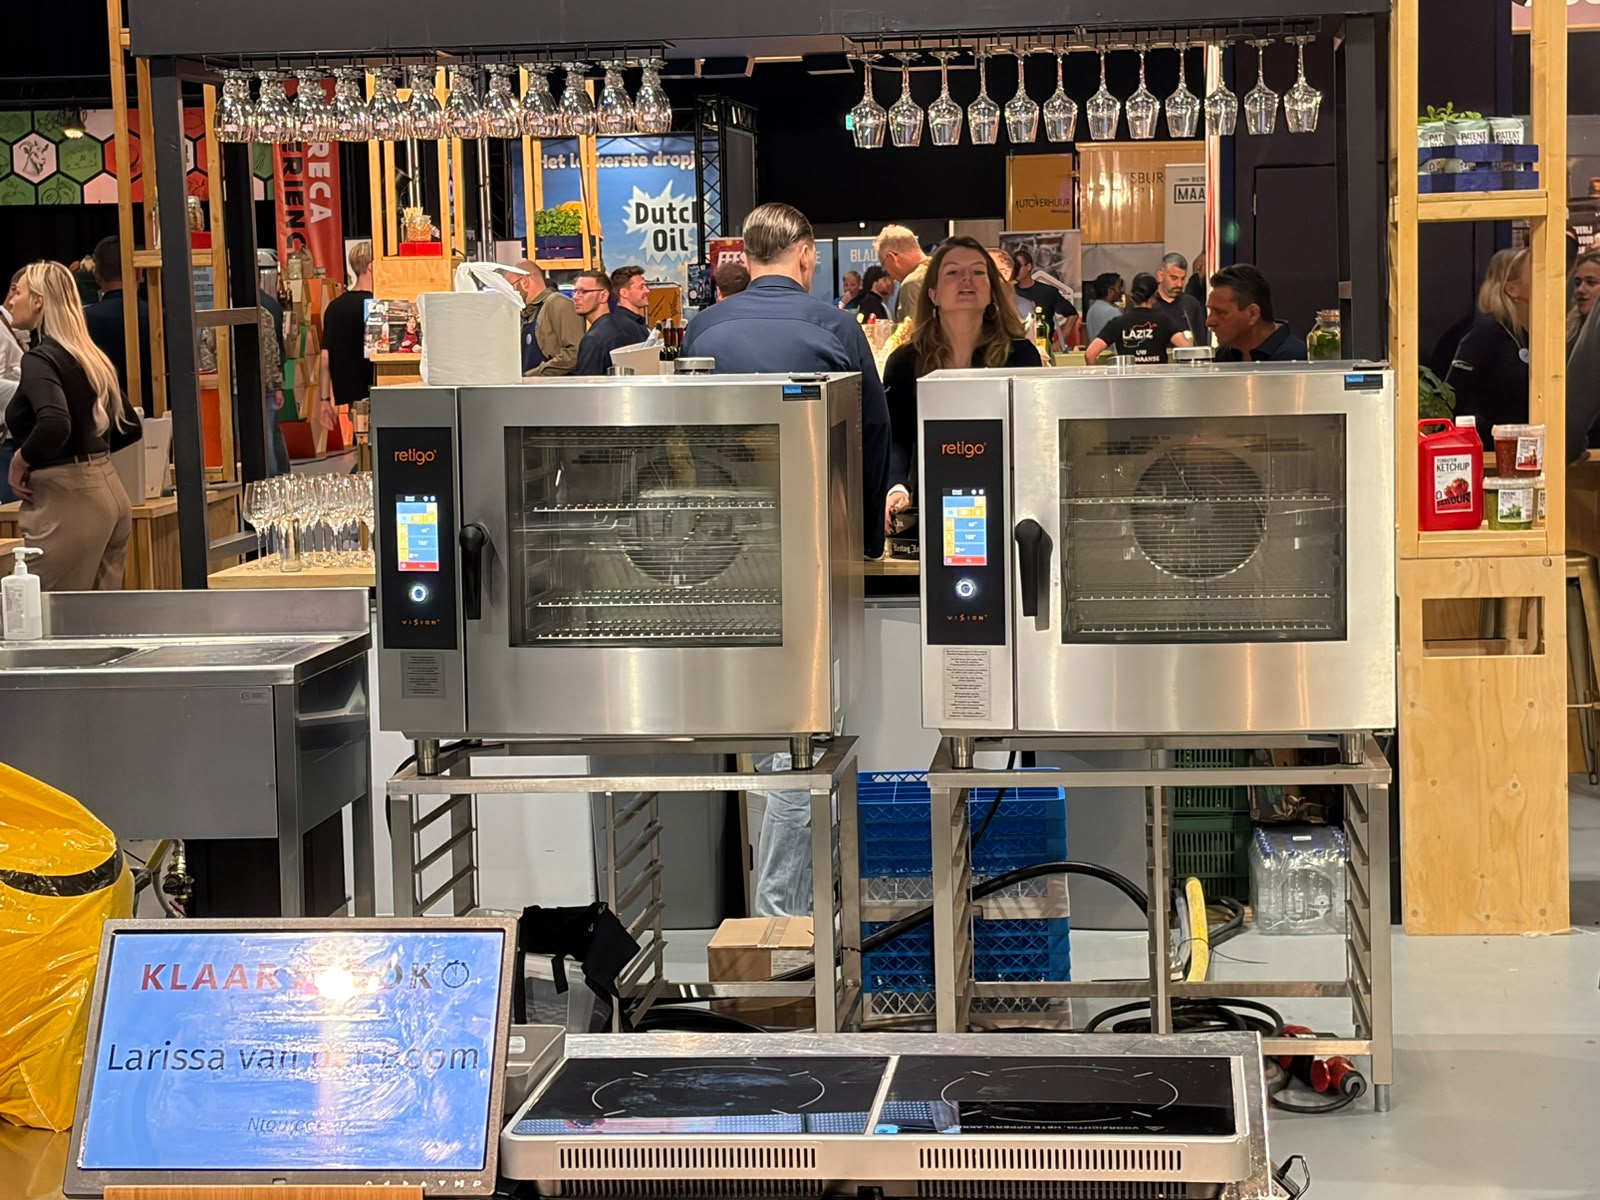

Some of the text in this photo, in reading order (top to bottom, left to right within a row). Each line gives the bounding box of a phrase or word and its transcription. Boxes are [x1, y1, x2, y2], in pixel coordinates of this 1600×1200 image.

[652, 151, 696, 170] dropj
[307, 142, 332, 224] RECA
[281, 142, 307, 250] ERIENC
[1177, 187, 1206, 201] MAA
[652, 228, 689, 252] Oil
[850, 249, 881, 262] BLAU
[1122, 328, 1154, 339] LAZIZ
[1134, 355, 1160, 363] HAANSE
[393, 448, 435, 466] retigo
[941, 441, 985, 459] retigo
[1436, 462, 1470, 472] KETCHUP
[107, 1040, 225, 1072] Larissa
